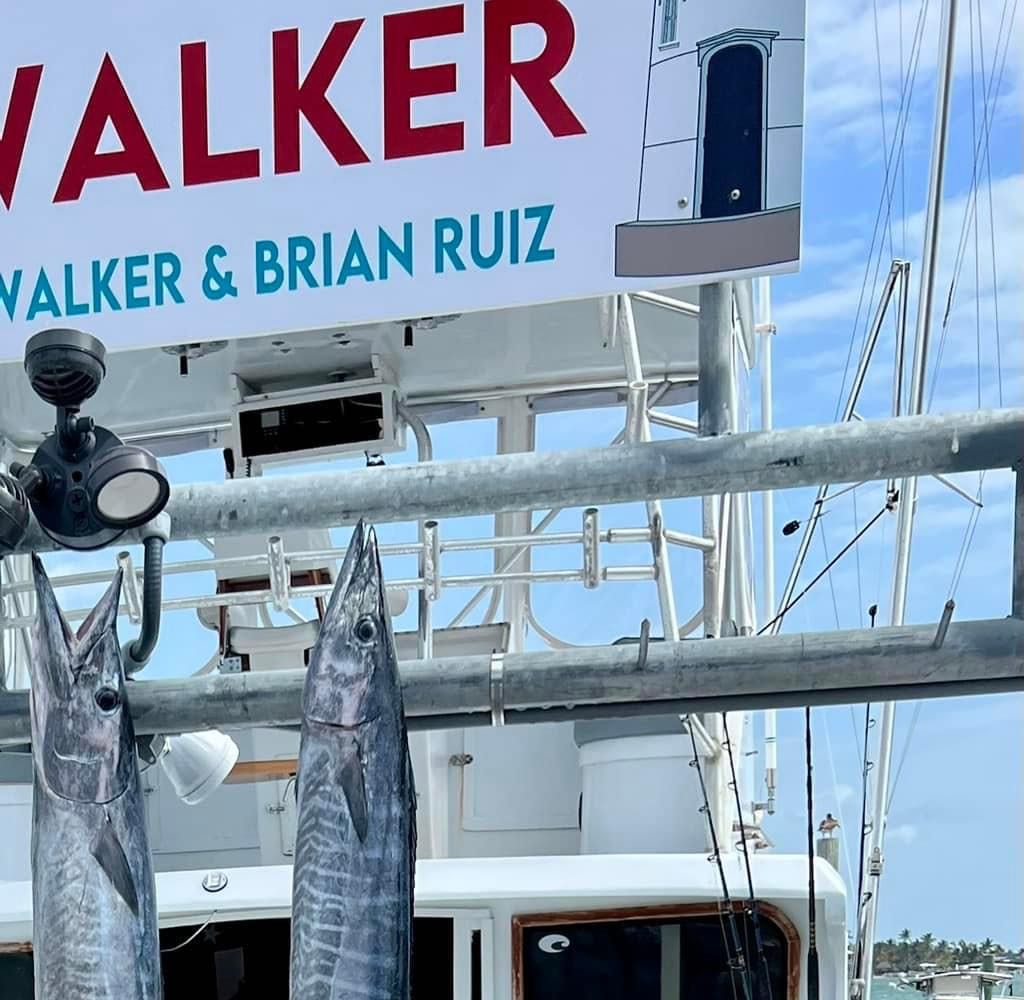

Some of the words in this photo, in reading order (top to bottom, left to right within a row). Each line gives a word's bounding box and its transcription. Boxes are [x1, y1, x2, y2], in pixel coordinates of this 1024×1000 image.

[201, 244, 238, 301] &
[255, 222, 413, 298] BRIAN
[434, 204, 555, 274] RUIZ
